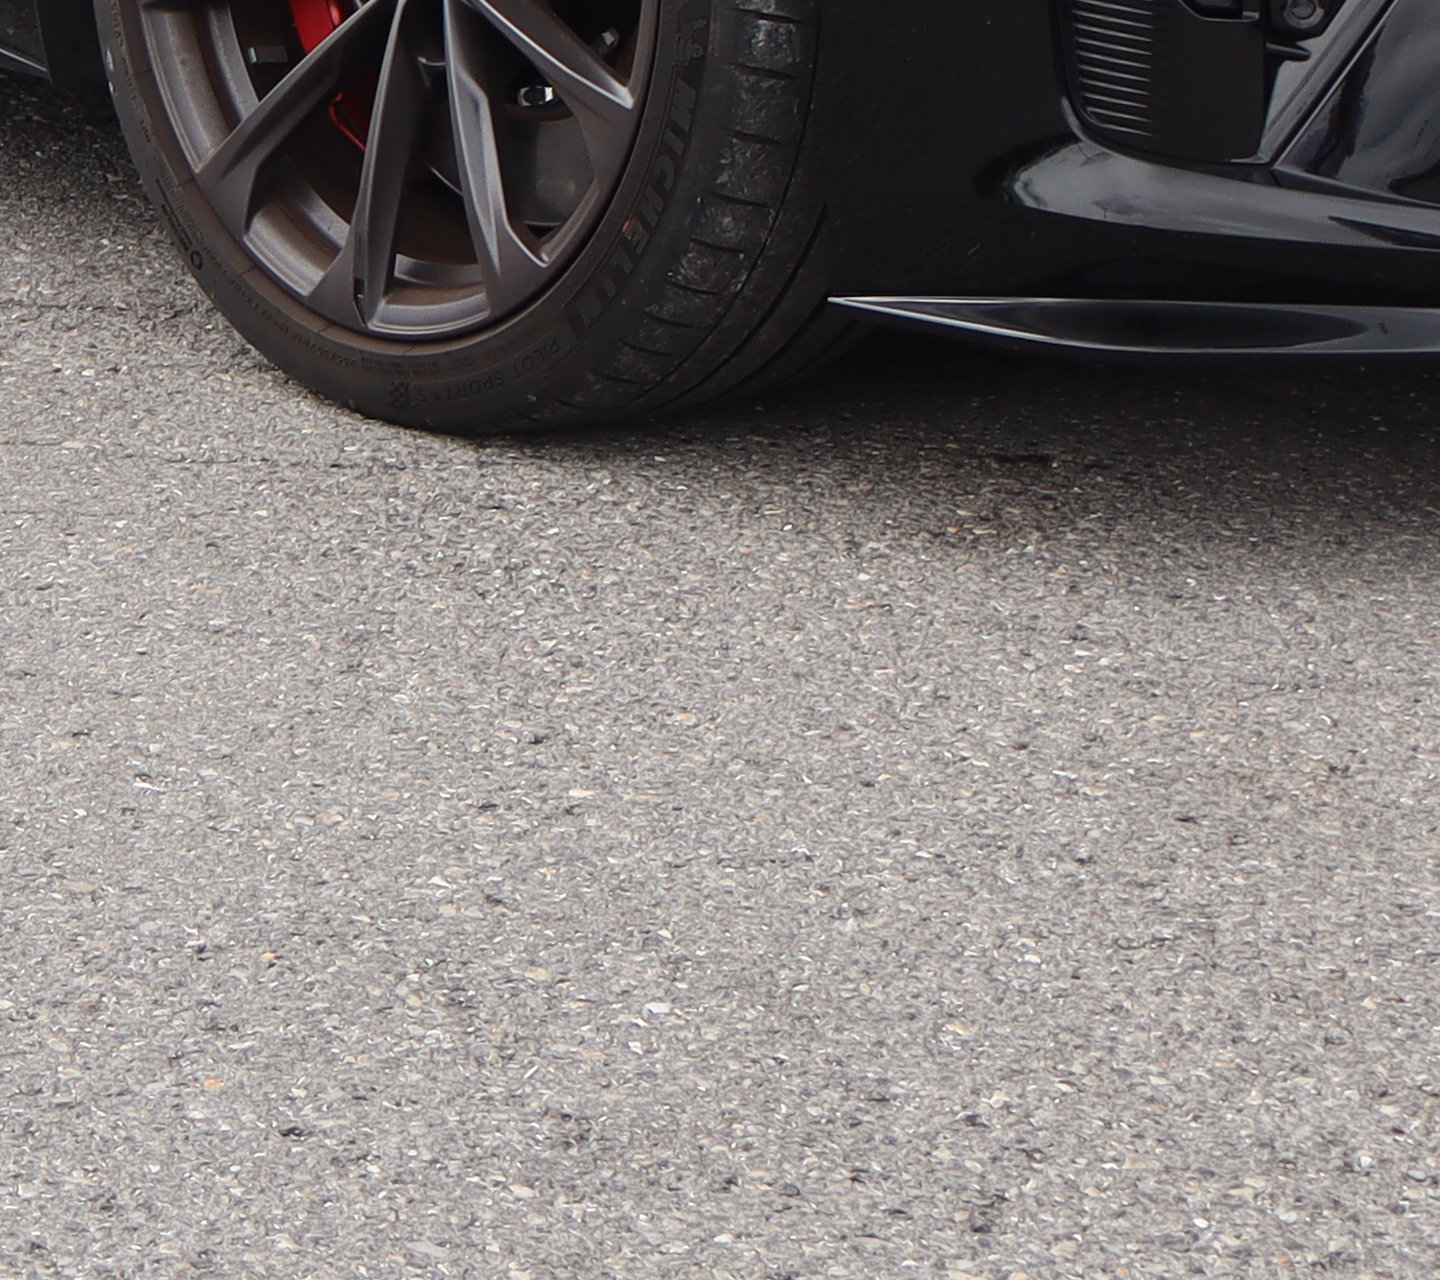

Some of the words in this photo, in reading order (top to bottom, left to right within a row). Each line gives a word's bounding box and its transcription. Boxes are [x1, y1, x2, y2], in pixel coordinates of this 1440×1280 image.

[575, 78, 697, 329] MICHELIN
[512, 337, 560, 380] PILOT
[444, 372, 505, 397] SPORT
